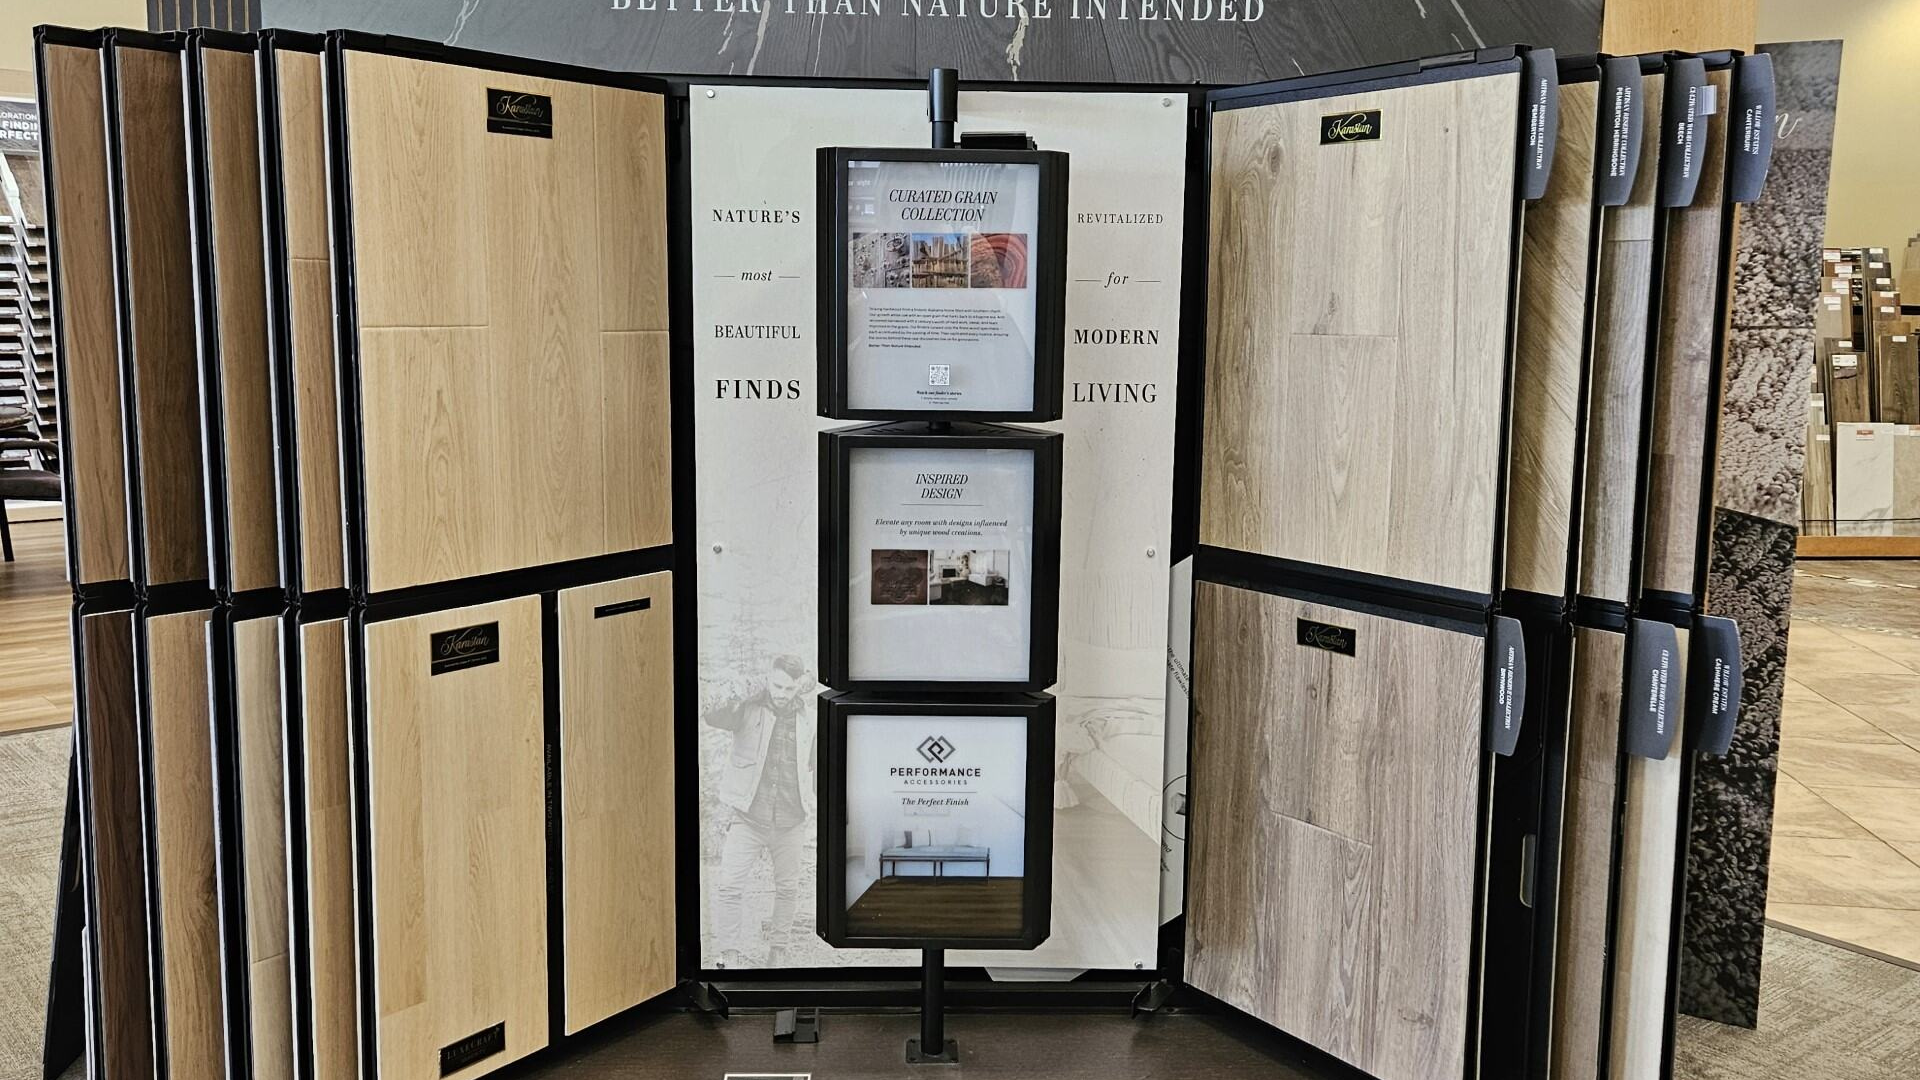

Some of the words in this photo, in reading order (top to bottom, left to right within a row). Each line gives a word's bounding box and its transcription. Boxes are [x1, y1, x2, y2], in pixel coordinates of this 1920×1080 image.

[1070, 0, 1265, 22] INTENDED
[1614, 87, 1623, 128] PEMBERTON
[1687, 86, 1696, 122] CULTIVATED
[1327, 113, 1373, 140] Karastan
[1530, 104, 1538, 146] PEMBERTON
[1538, 104, 1546, 132] RESERVE
[1622, 113, 1630, 139] RESERVE
[1677, 122, 1685, 144] BEECH
[1686, 123, 1694, 141] WOOD
[1744, 109, 1752, 151] CANTERBURY
[1610, 129, 1619, 176] HERRINGBONE
[1752, 129, 1760, 155] ESTATES
[1619, 140, 1628, 176] COLLECTION
[1683, 142, 1692, 178] COLLECTION
[889, 188, 952, 203] CURATED
[955, 190, 998, 205] GRAIN
[712, 208, 800, 224] NATURE'S
[901, 207, 985, 222] COLLECTION
[1077, 212, 1164, 224] REVITALIZED
[741, 269, 772, 281] most
[1104, 271, 1129, 288] for
[714, 324, 801, 339] BEAUTIFUL
[1073, 329, 1160, 345] MODERN
[715, 379, 800, 400] FINDS
[1072, 382, 1157, 404] LIVING
[915, 473, 969, 485] INSPIRED
[920, 487, 964, 499] DESIGN
[875, 518, 900, 526] Elevate
[948, 519, 973, 527] designs
[973, 519, 1008, 528] influenced
[899, 529, 907, 537] by
[908, 529, 931, 537] unique
[951, 529, 983, 537] creations.
[1661, 650, 1669, 683] CULTIVATED
[1713, 658, 1722, 691] CASHMERE
[1650, 669, 1659, 712] CHANTERELLE
[1721, 687, 1729, 711] ESTATES
[1504, 695, 1512, 730] COLLECTION
[1656, 701, 1665, 735] COLLECTION
[890, 767, 981, 777] PERFORMANCE
[901, 797, 917, 806] The
[917, 797, 944, 807] Perfect
[945, 798, 969, 806] Finish
